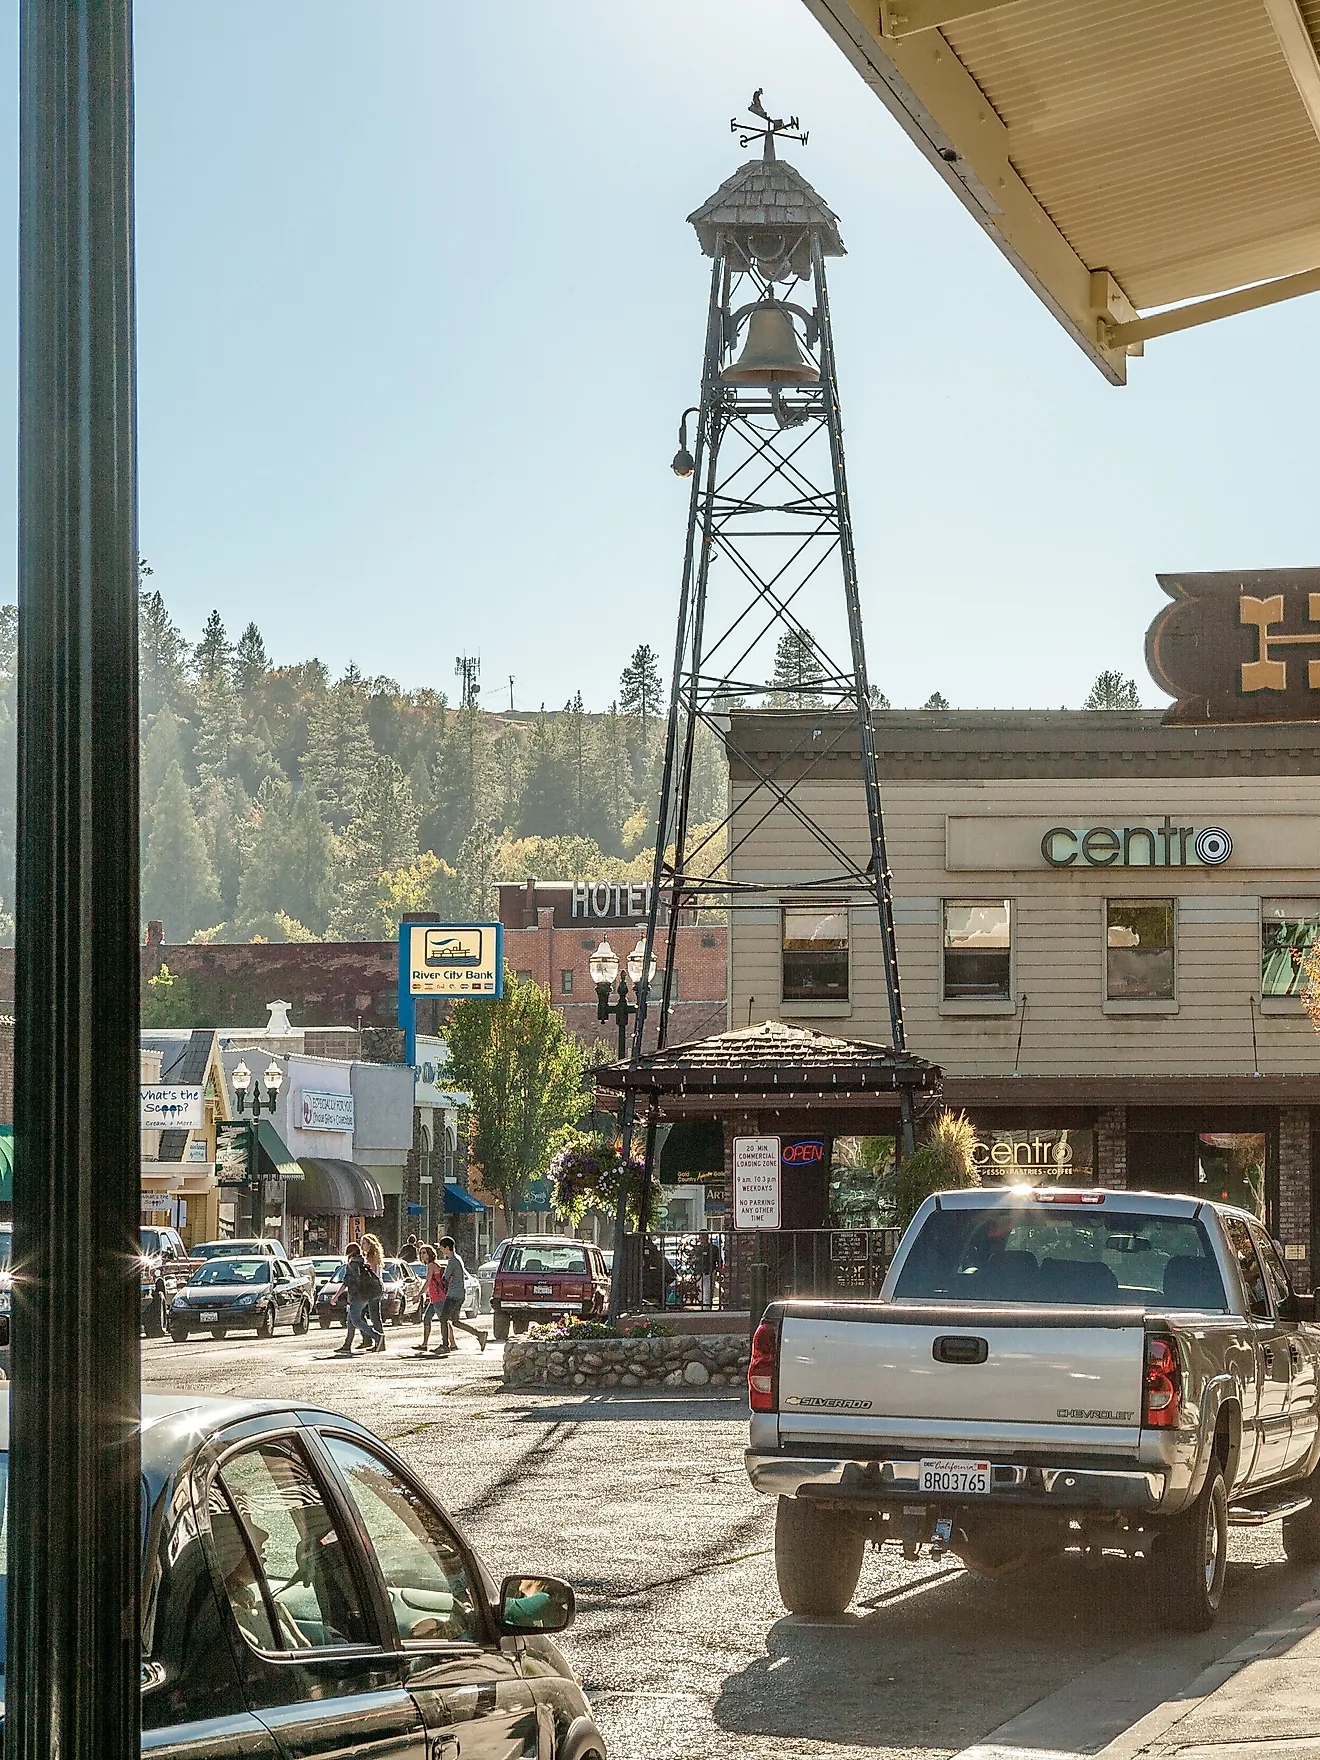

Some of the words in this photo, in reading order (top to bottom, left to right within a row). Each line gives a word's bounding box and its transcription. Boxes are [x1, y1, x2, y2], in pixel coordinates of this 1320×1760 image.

[1041, 815, 1233, 866] centro
[412, 971, 440, 979] River
[443, 971, 463, 980] City
[465, 971, 493, 979] Bank
[180, 1090, 199, 1100] the
[783, 1145, 824, 1161] OPEN
[971, 1137, 1073, 1164] centro
[1047, 1168, 1073, 1176] COFFEE
[801, 1397, 873, 1409] SILVERADO
[1056, 1408, 1135, 1420] CHEVROLET
[934, 1461, 974, 1472] California
